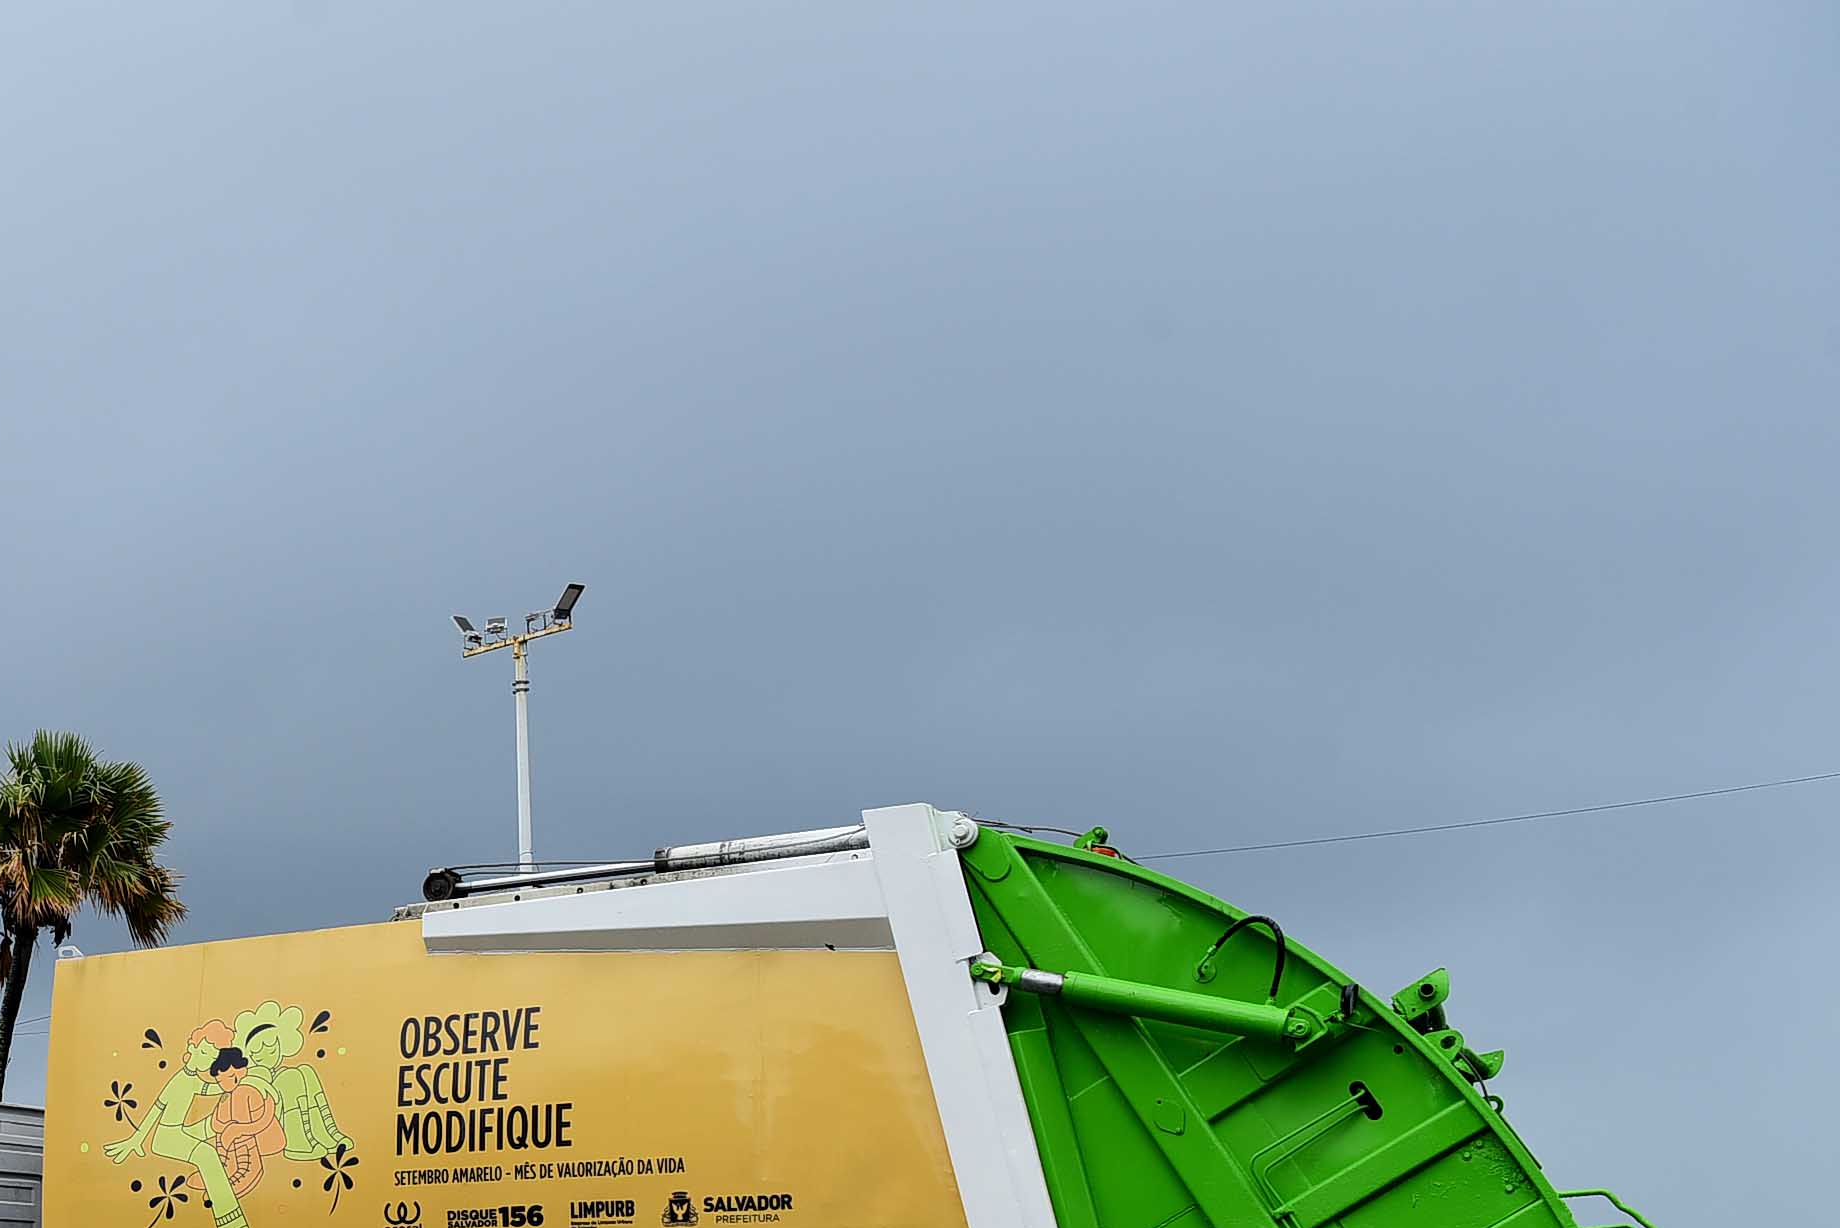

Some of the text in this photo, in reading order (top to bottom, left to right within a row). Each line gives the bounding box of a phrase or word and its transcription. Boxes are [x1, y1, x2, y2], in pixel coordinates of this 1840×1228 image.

[399, 1006, 542, 1059] OBSERVE
[397, 1058, 509, 1107] ESCUTE
[395, 1102, 573, 1156] MODIFIQUE
[394, 1168, 449, 1186] SETEMBRO
[451, 1165, 503, 1183] AMARELO
[514, 1161, 536, 1180] MÊS
[540, 1163, 554, 1179] DE
[557, 1156, 634, 1178] VALORIZAÇÃO
[637, 1159, 653, 1175] DA
[657, 1157, 685, 1174] VIDA
[570, 1200, 635, 1219] LIMPURB
[703, 1193, 793, 1213] SALVADOR
[447, 1208, 497, 1221] DISQUE
[448, 1219, 498, 1228] SALVADOR
[498, 1204, 545, 1227] 156
[715, 1213, 780, 1224] PREFEITURA
